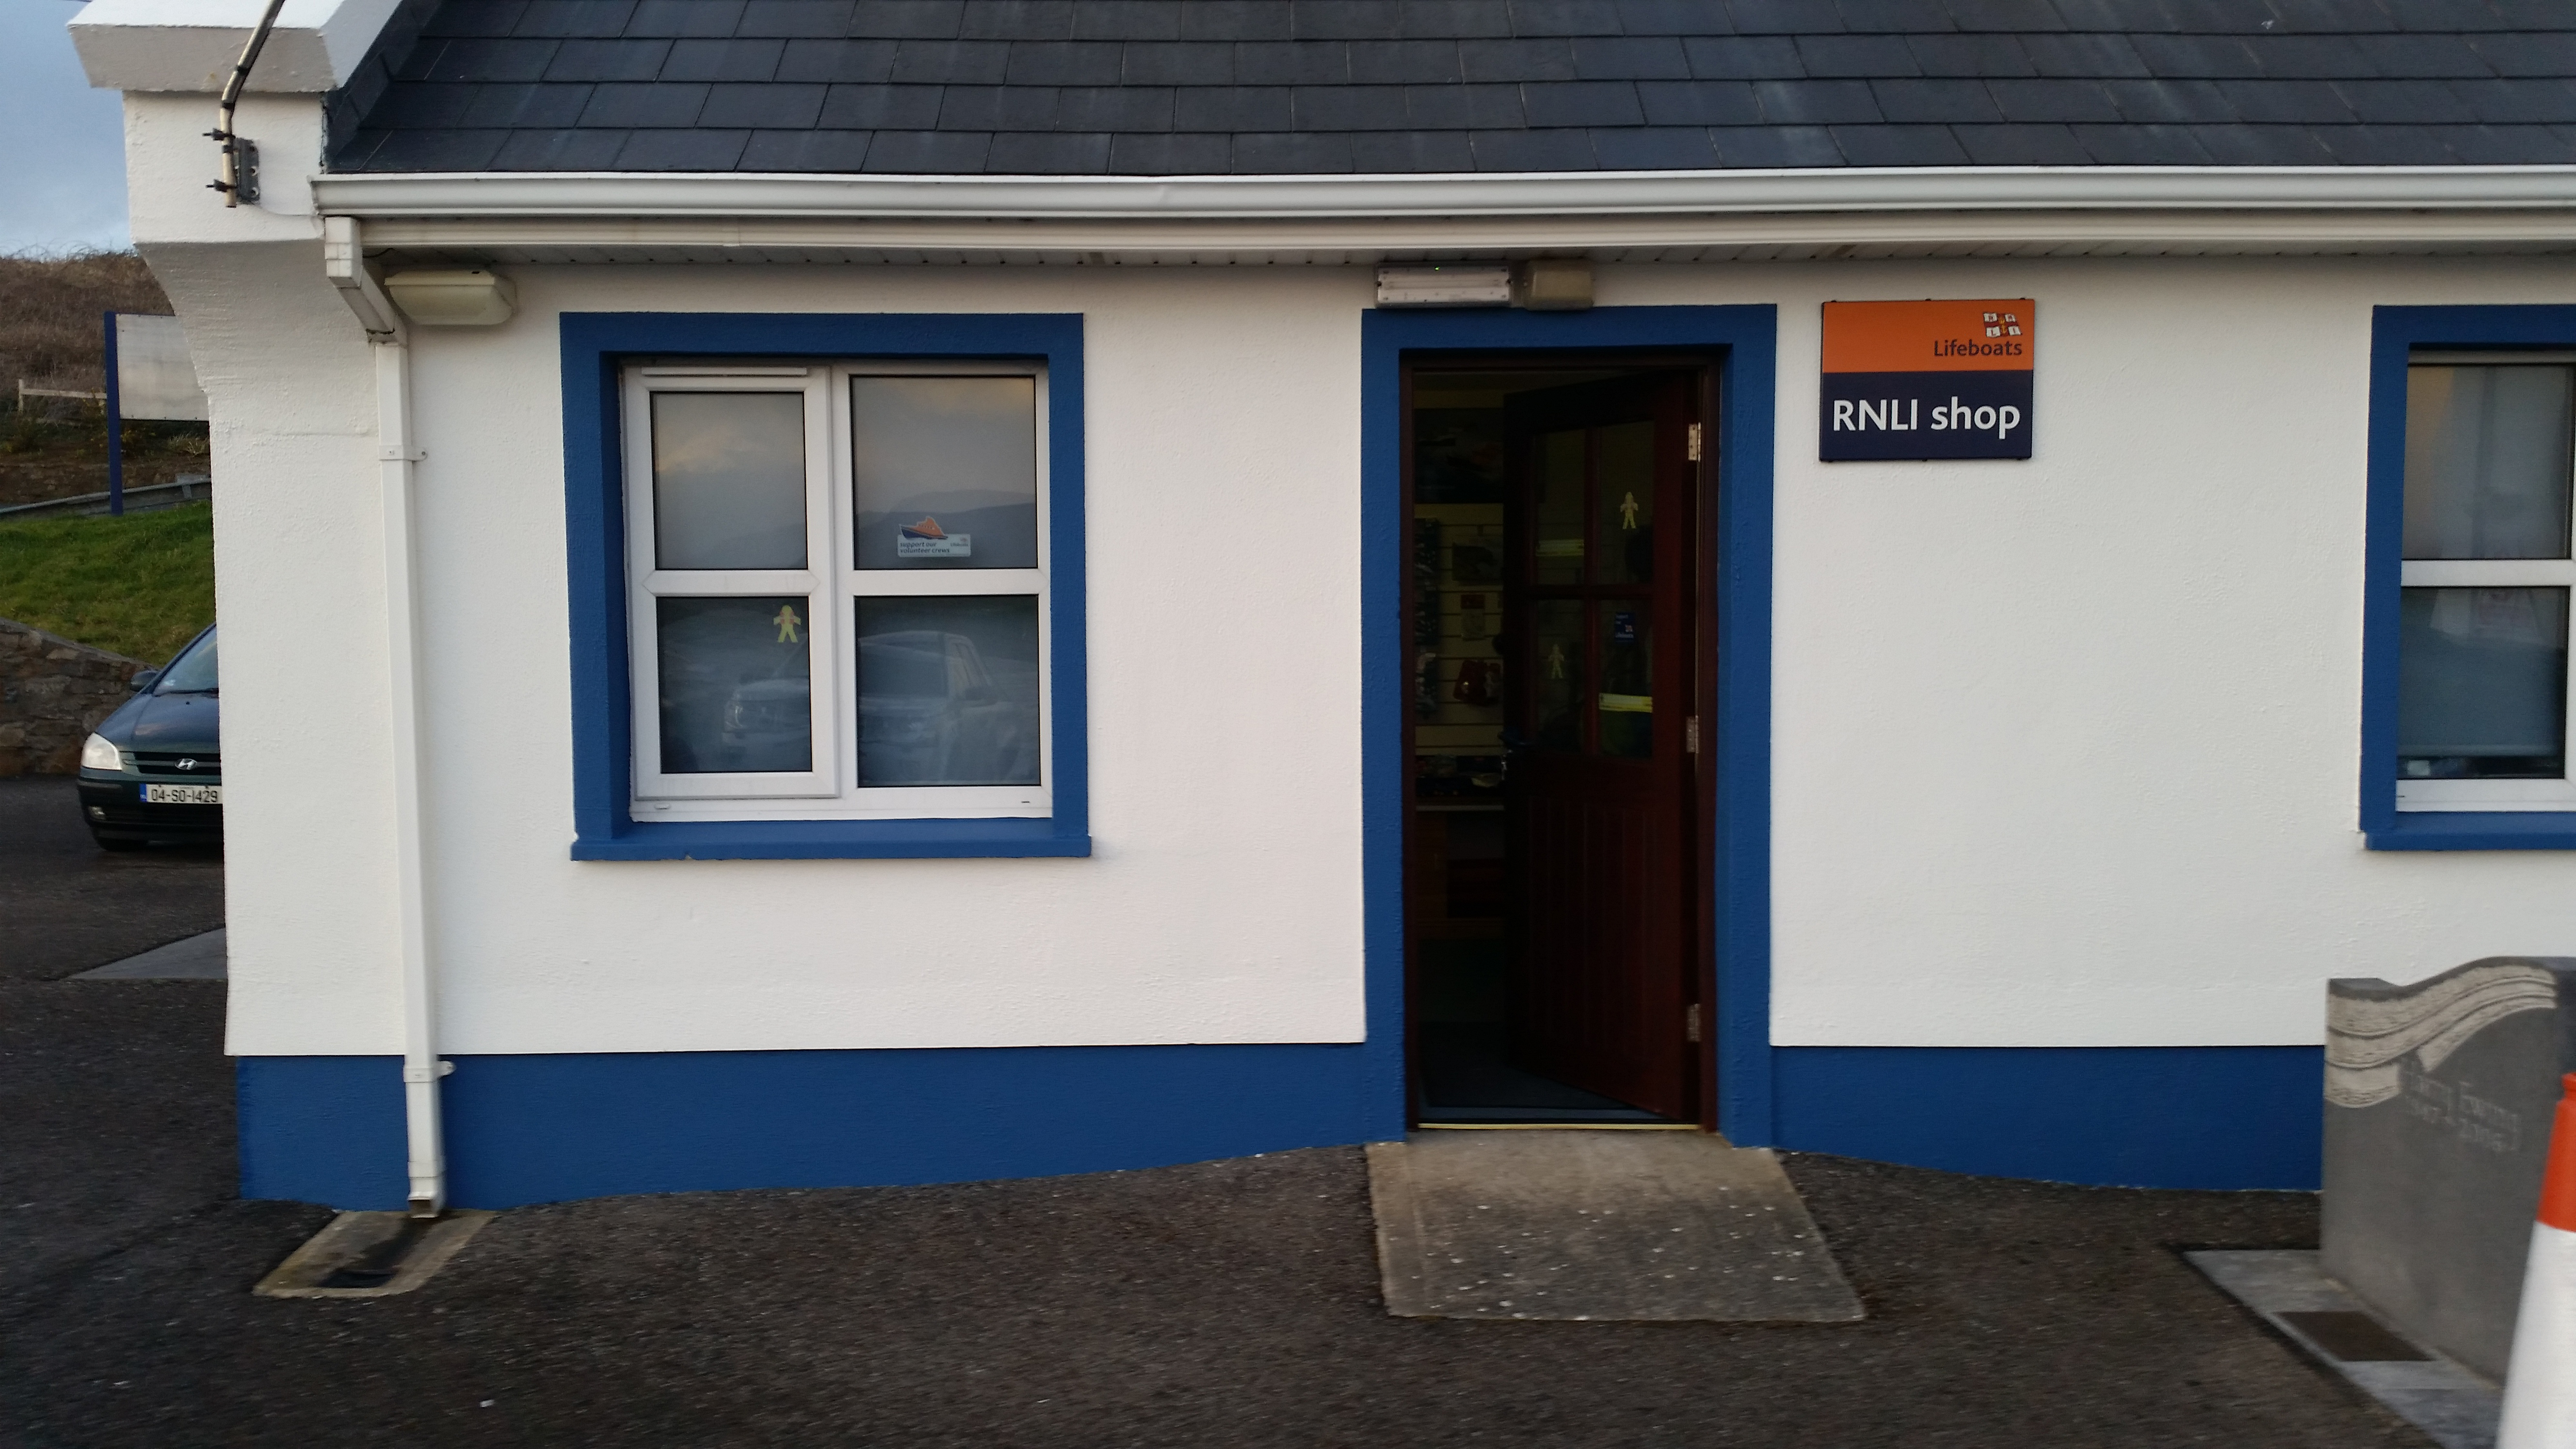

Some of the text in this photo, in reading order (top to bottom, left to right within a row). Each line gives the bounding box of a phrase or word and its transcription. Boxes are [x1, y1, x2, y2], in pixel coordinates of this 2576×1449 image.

[1933, 339, 2023, 356] Lifeboats
[1833, 396, 2021, 440] RNLI shop
[151, 789, 217, 803] 04-SO-1429
